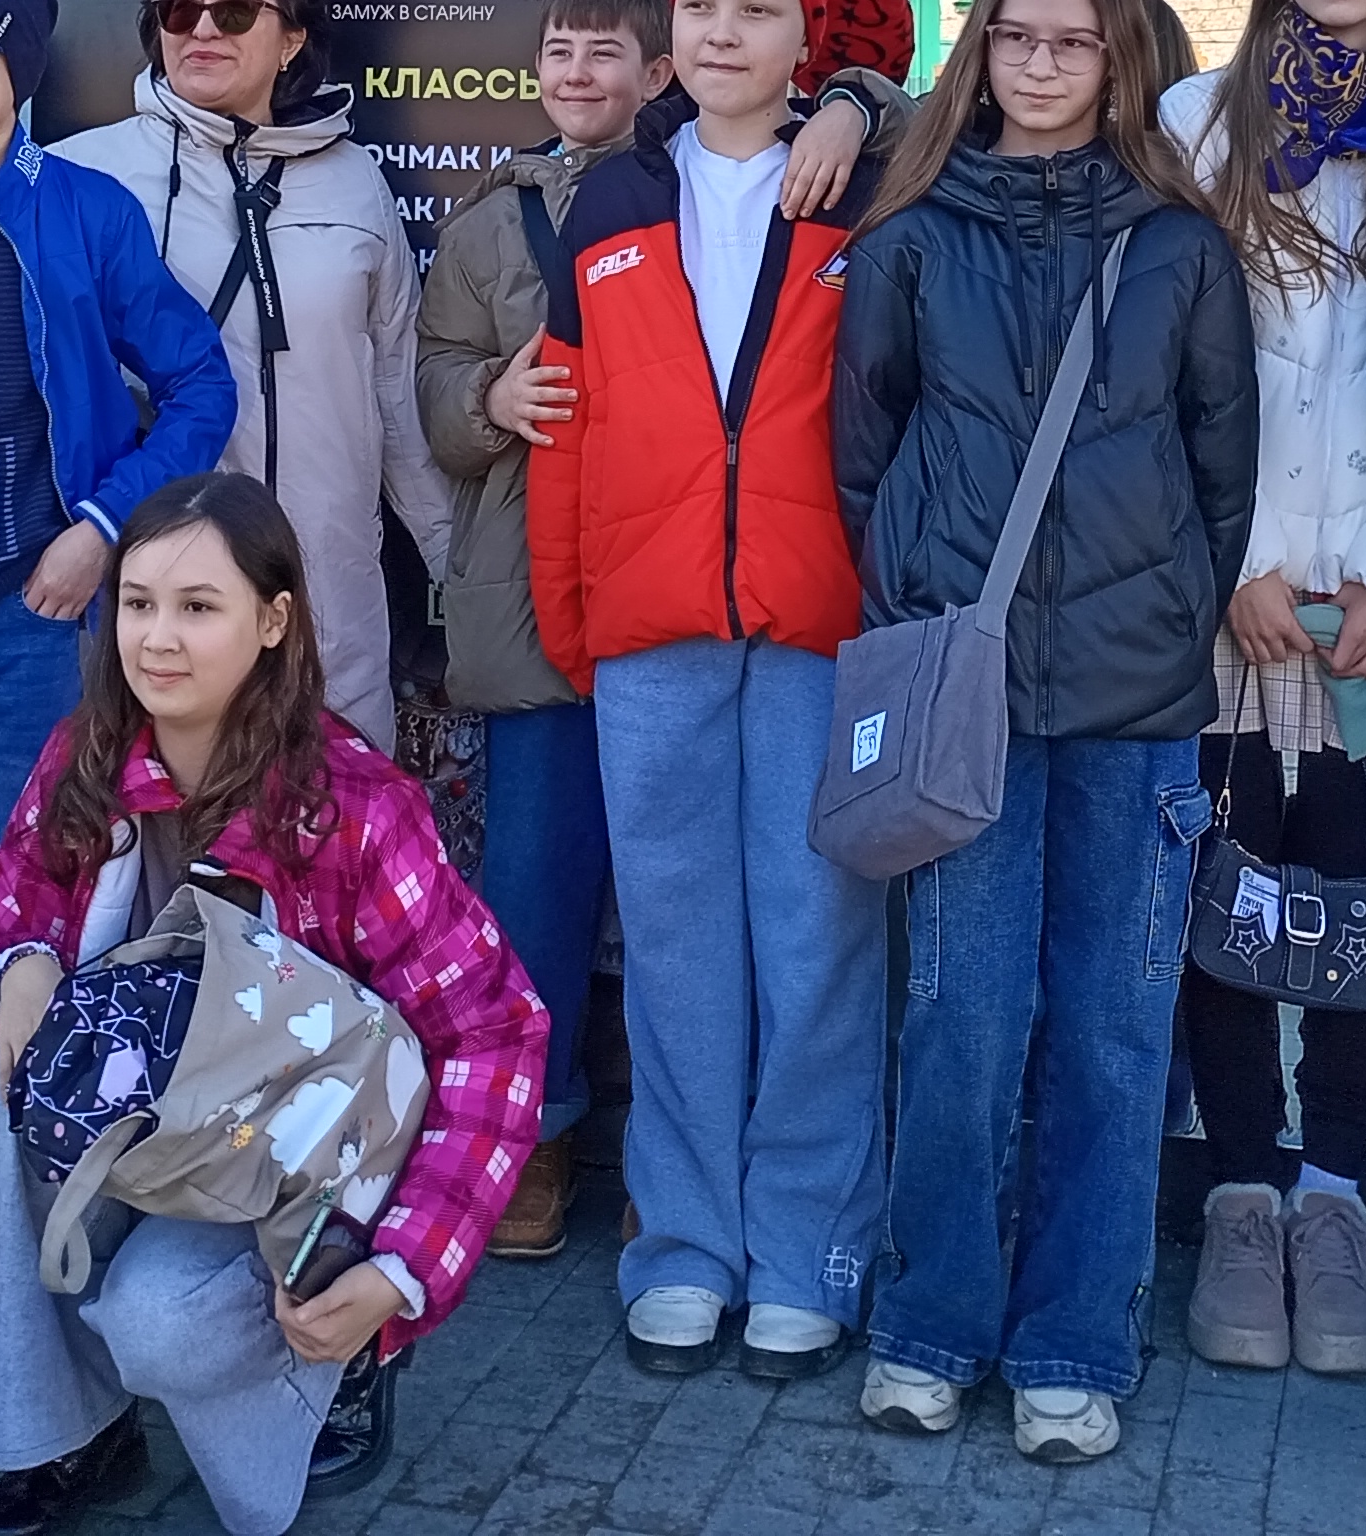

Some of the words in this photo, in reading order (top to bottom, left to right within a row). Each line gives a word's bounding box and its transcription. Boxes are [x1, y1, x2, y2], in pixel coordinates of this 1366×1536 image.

[331, 4, 395, 20] ЗАМУЖ
[400, 5, 410, 20] В
[414, 5, 495, 21] СТАРИНУ
